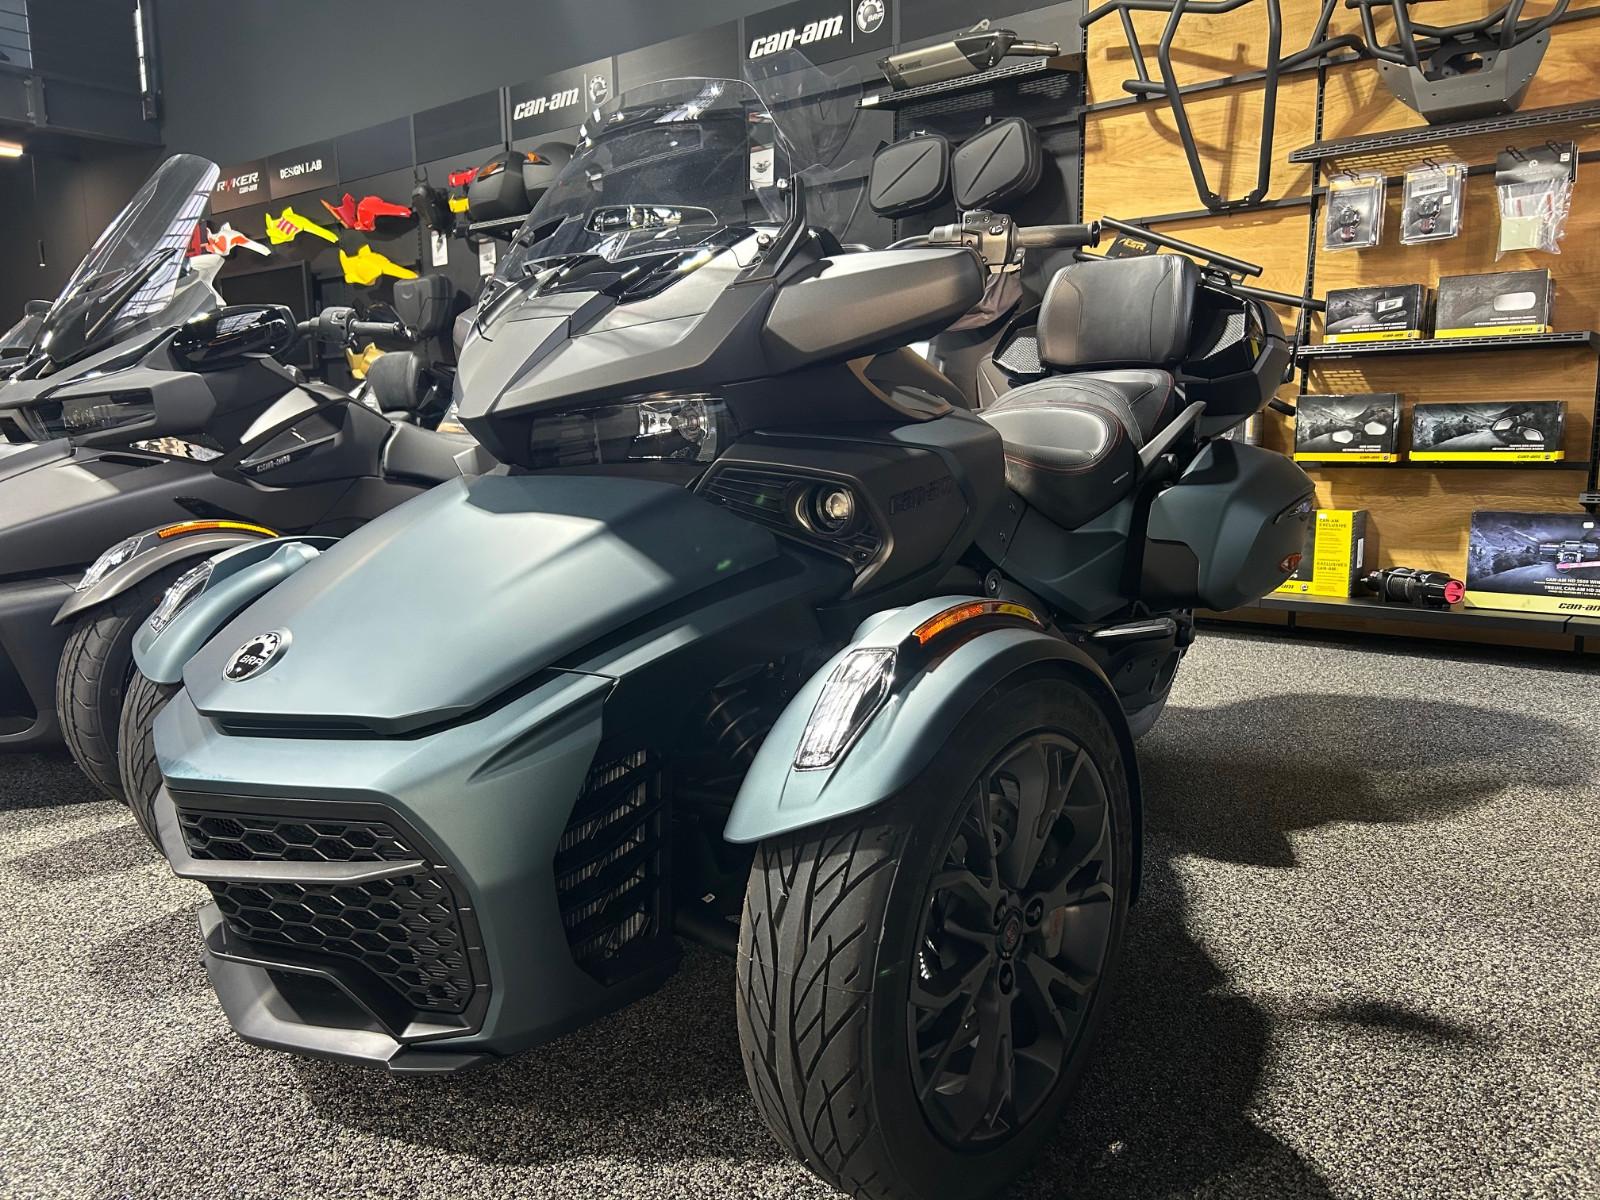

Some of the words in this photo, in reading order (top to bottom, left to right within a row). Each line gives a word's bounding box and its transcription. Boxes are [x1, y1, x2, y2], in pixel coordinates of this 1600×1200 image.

[279, 162, 305, 180] DESIGN
[305, 159, 323, 173] LAB
[216, 172, 259, 192] RYKER
[239, 654, 264, 667] BRP
